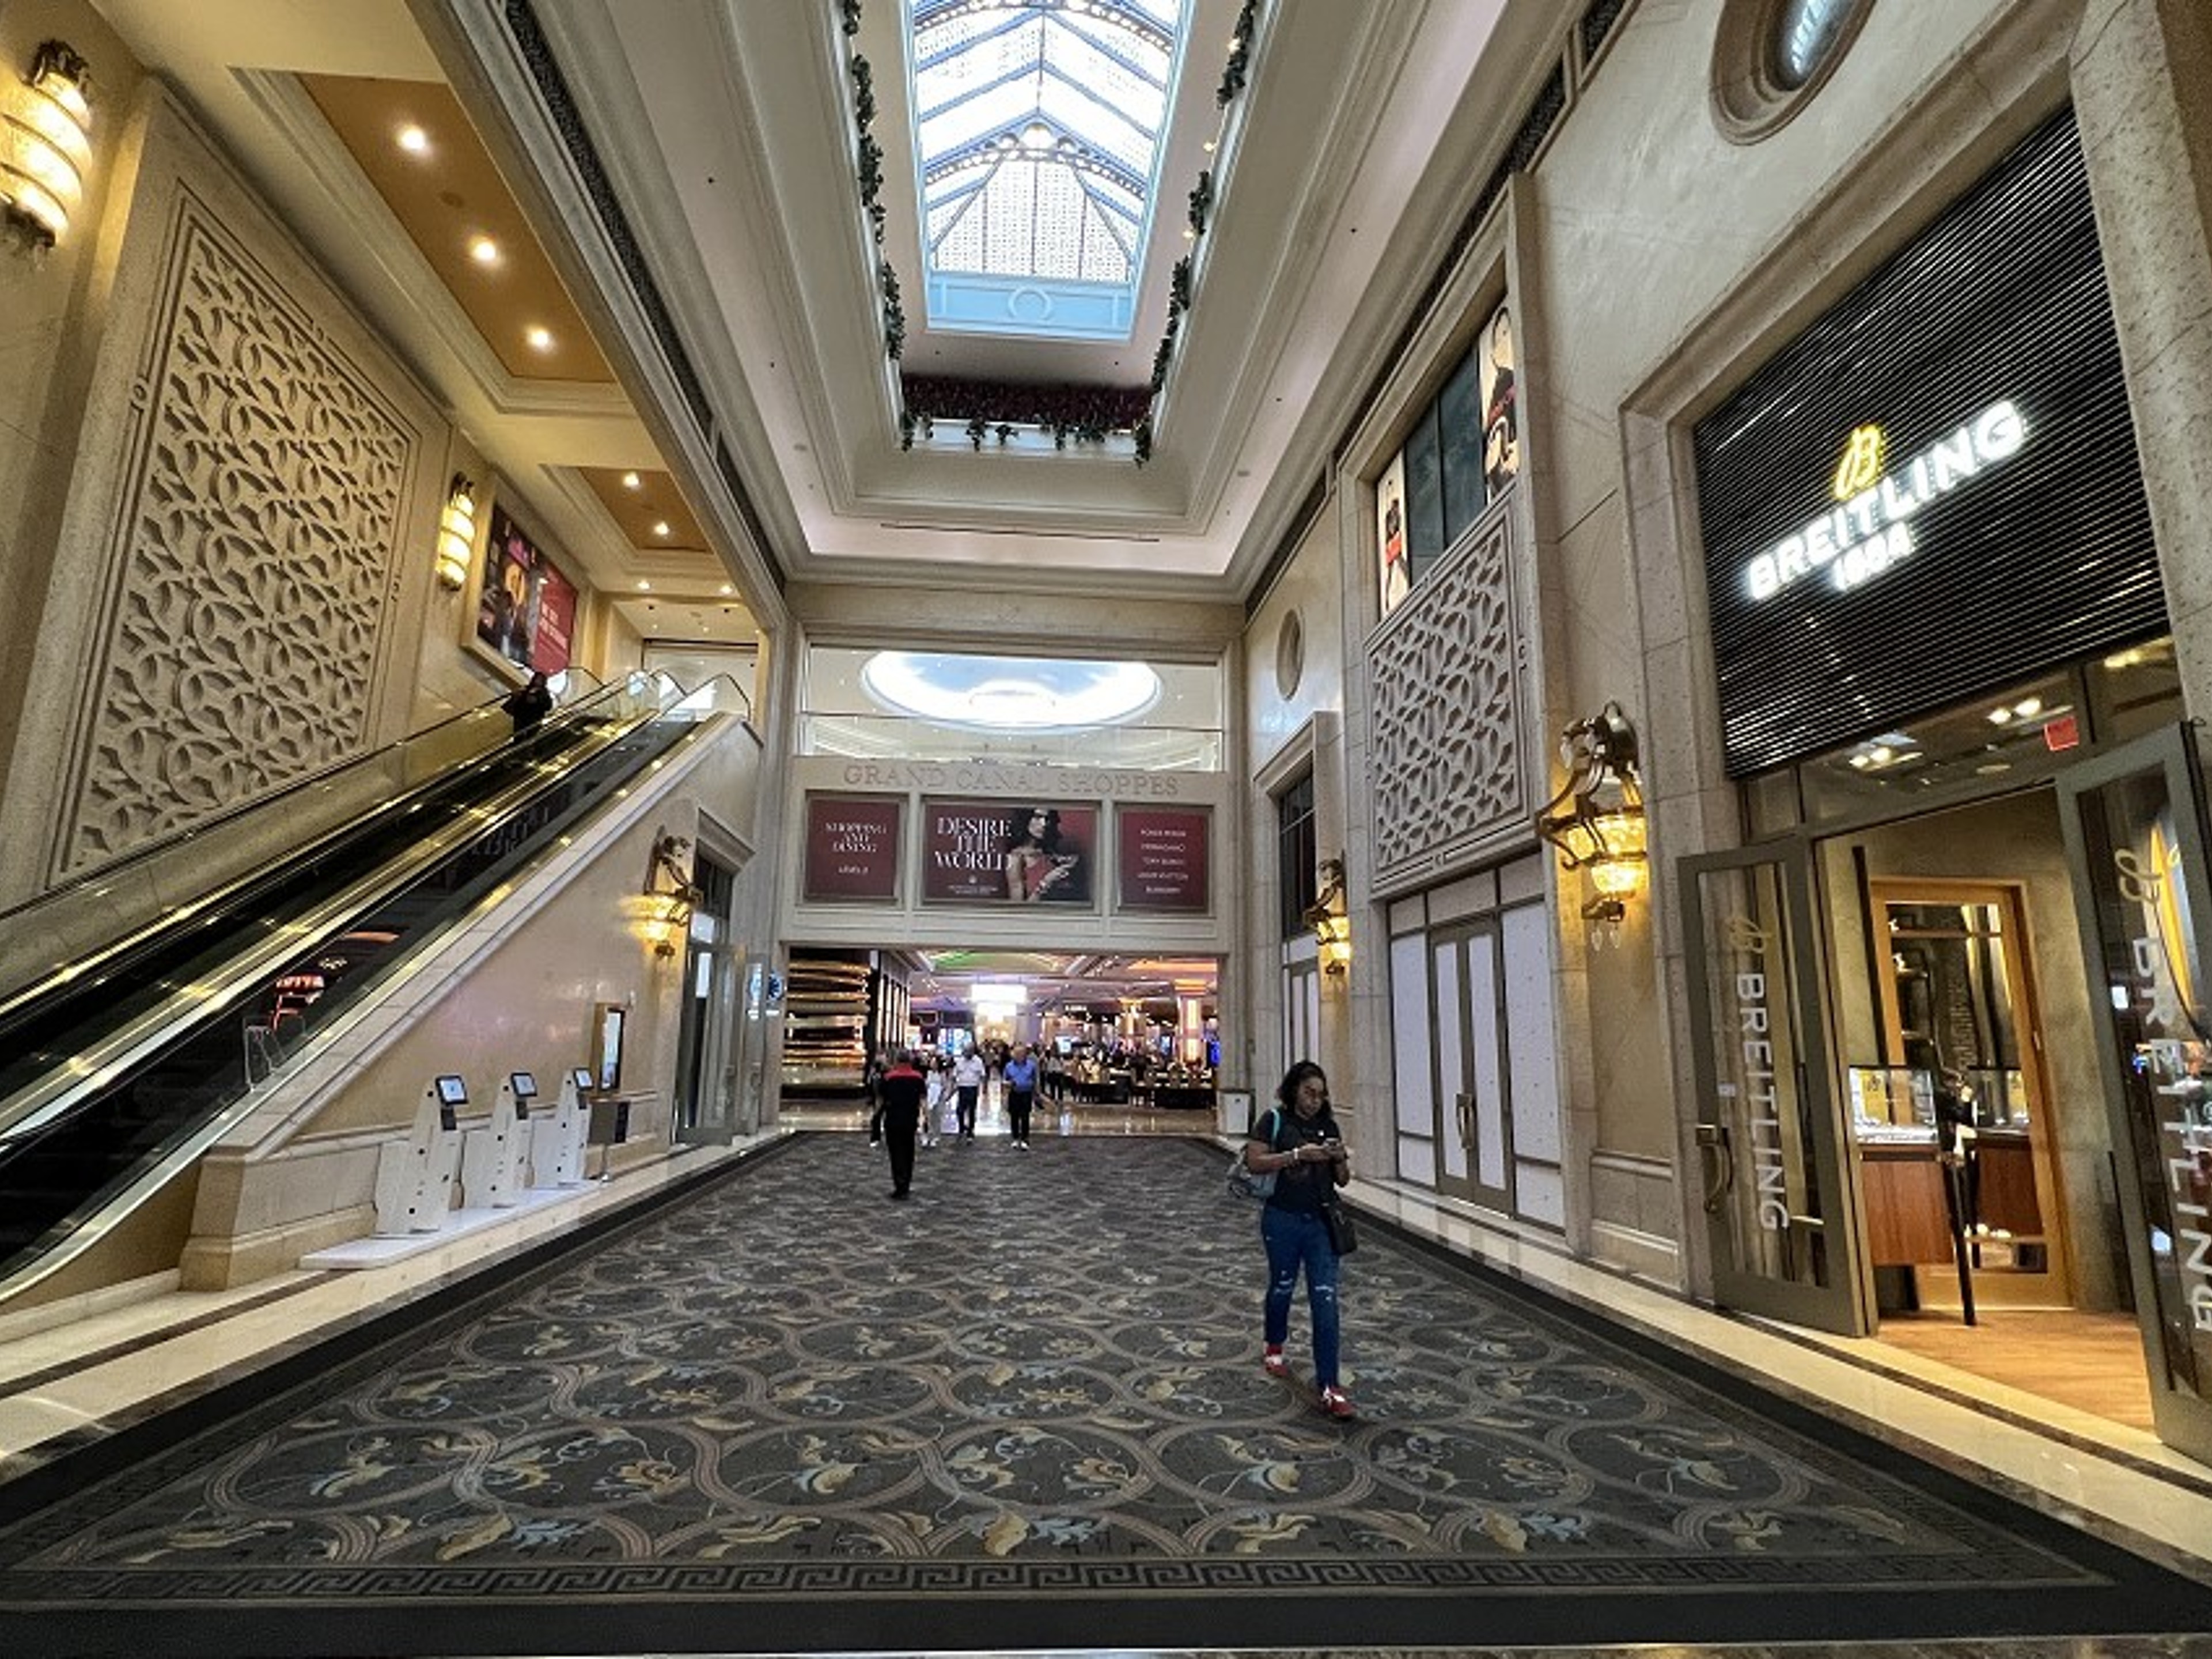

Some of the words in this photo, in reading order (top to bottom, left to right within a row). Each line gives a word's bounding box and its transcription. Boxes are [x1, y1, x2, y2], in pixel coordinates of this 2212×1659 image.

[1749, 399, 2025, 600] BREITLING
[844, 765, 946, 786] GRAND
[956, 768, 1050, 791] CANAL
[1058, 772, 1179, 796] SHOPPES
[937, 817, 1012, 837] DESIRE
[955, 832, 998, 853] THE
[934, 851, 1013, 871] WORLD
[1737, 973, 1789, 1231] BREITLING
